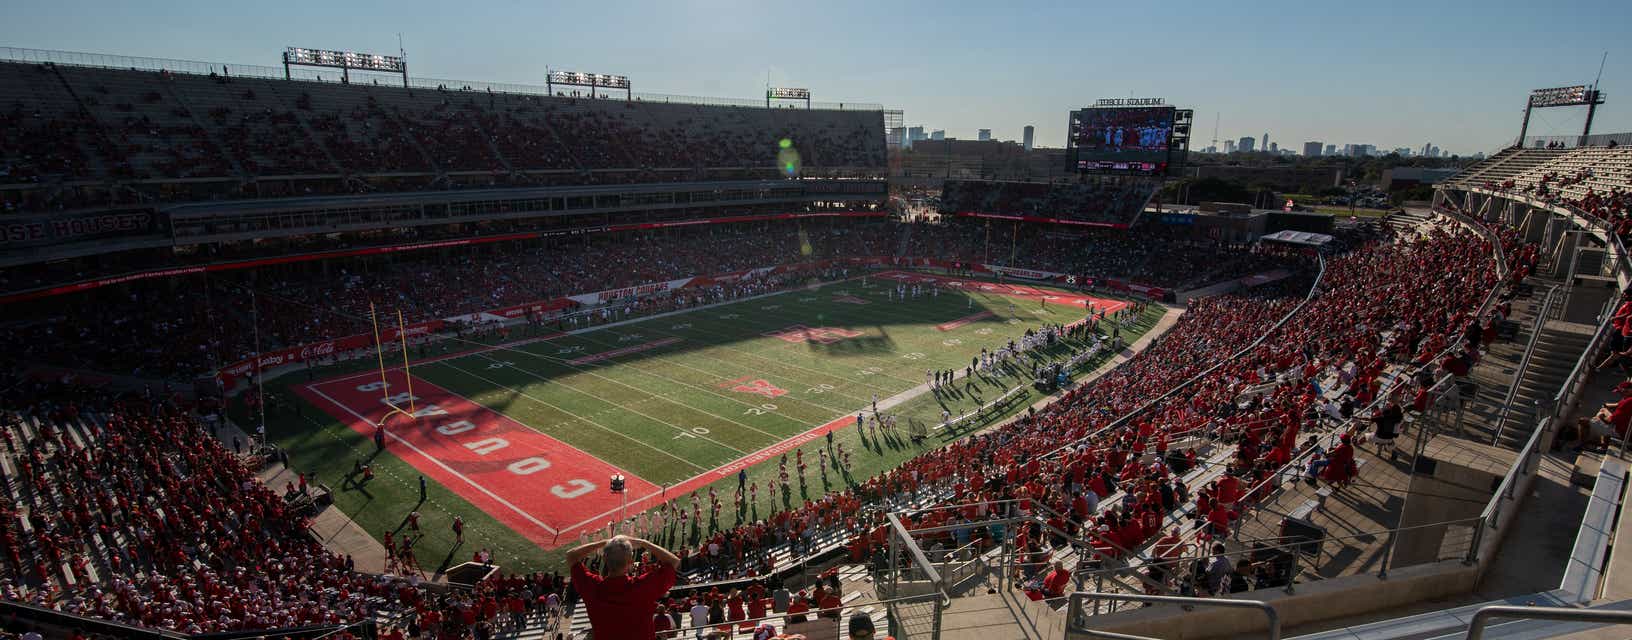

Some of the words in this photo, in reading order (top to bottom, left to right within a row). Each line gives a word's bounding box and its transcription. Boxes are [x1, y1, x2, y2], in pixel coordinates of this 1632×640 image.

[1127, 97, 1162, 106] STADIUM
[598, 288, 634, 302] HOUSTON
[637, 282, 670, 295] COUGARS
[743, 402, 778, 416] 20
[356, 380, 600, 500] COUGARS
[671, 426, 711, 440] 10
